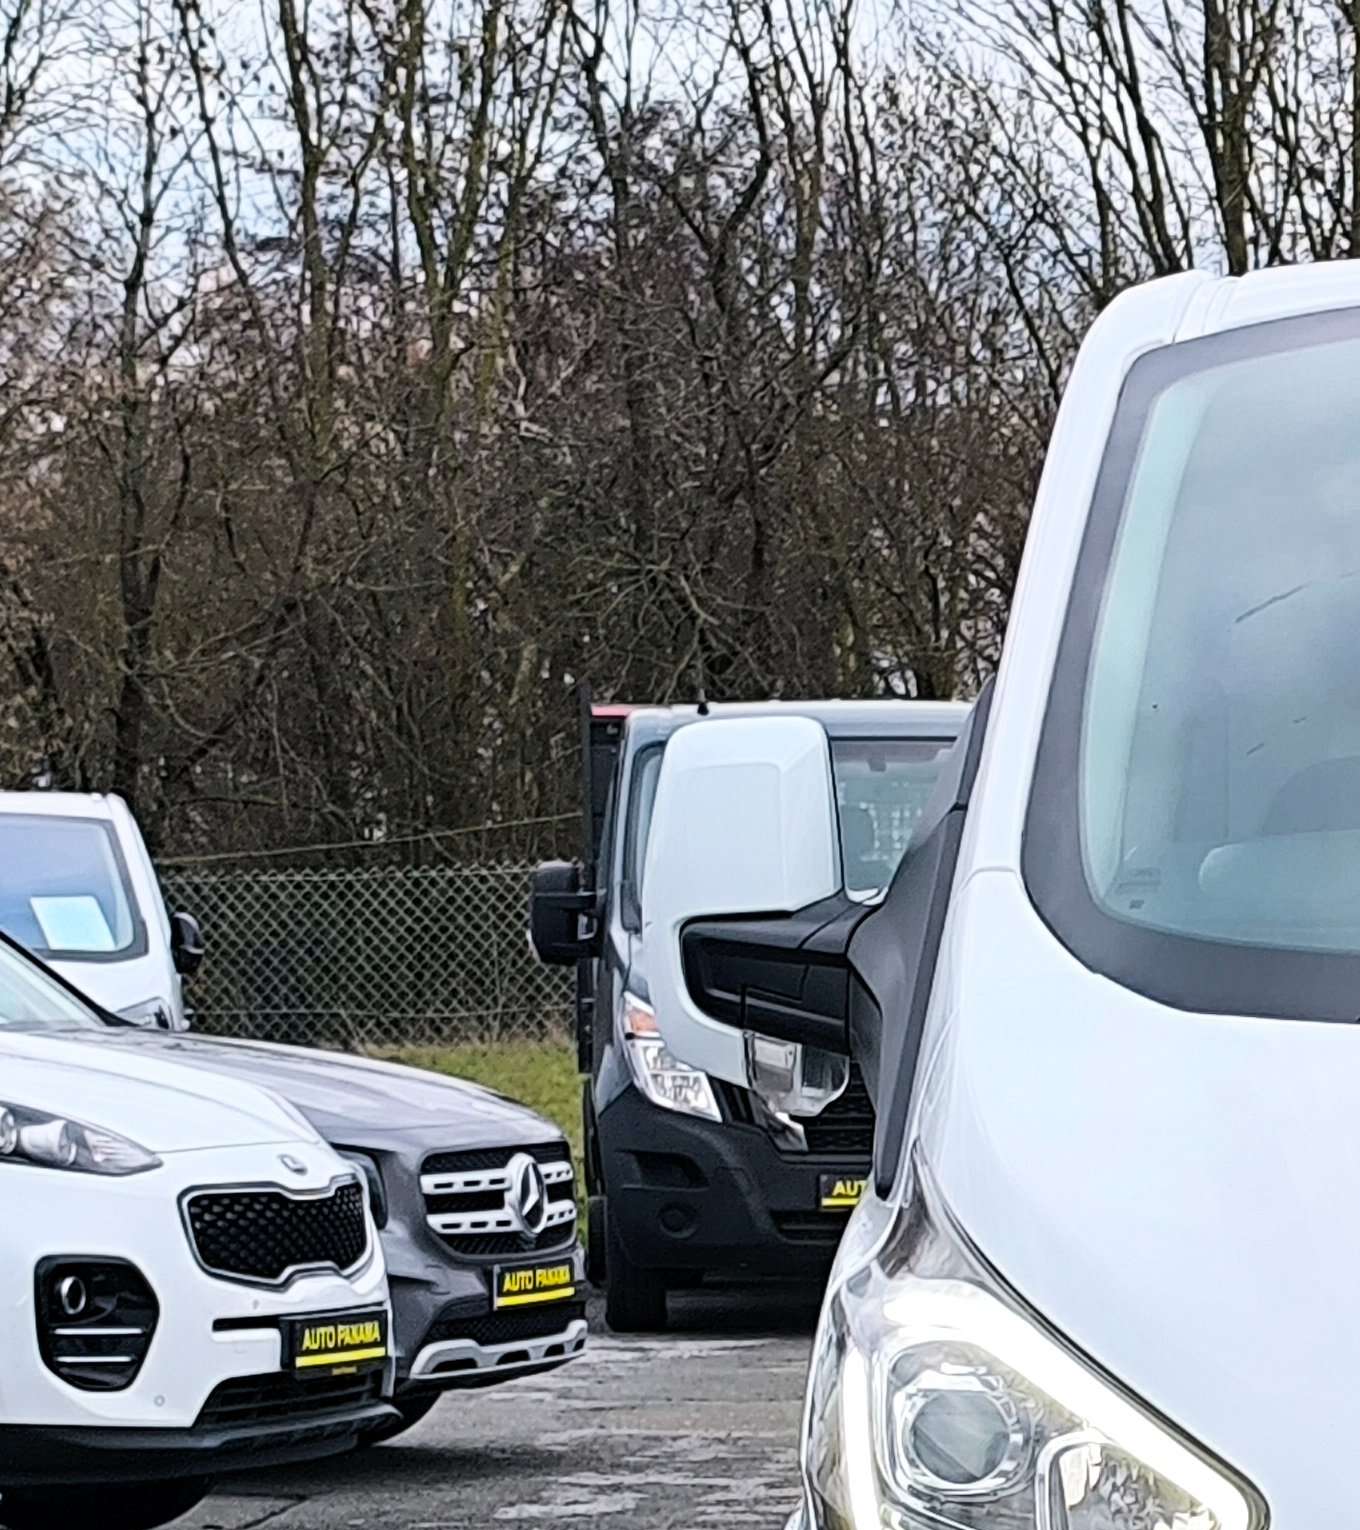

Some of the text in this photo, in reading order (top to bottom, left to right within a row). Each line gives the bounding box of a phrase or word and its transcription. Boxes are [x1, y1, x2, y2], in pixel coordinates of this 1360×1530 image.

[831, 1180, 867, 1196] AUT
[503, 1270, 534, 1292] AUTO
[302, 1326, 336, 1351] AUTO
